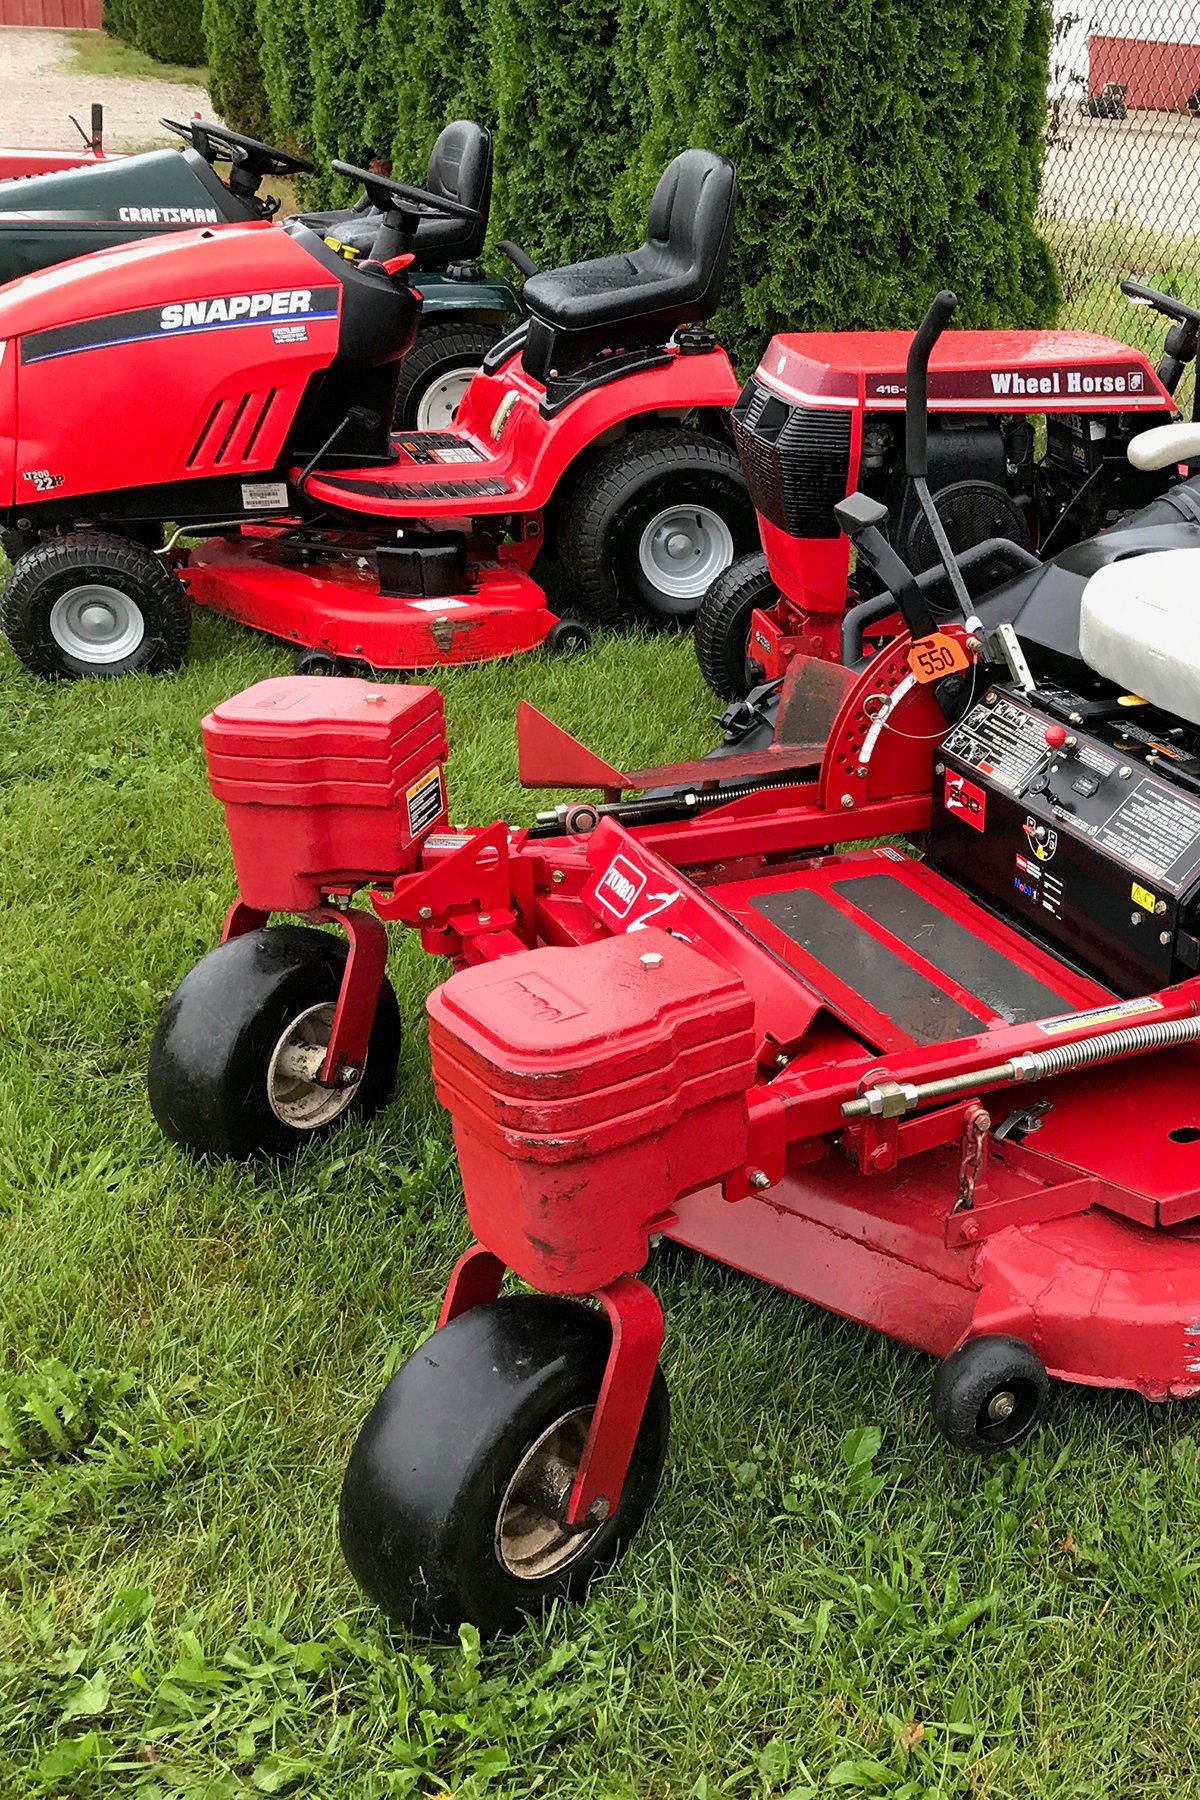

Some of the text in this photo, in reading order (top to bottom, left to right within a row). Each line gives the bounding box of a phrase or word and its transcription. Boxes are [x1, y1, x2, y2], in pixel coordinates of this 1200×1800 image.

[119, 207, 218, 223] CRAFTSMAN
[160, 290, 312, 330] SNAPPER
[876, 385, 908, 394] 416-
[991, 372, 1126, 394] Wheel Horse
[23, 470, 50, 481] LT200
[917, 646, 955, 675] 550
[604, 867, 636, 904] TORO
